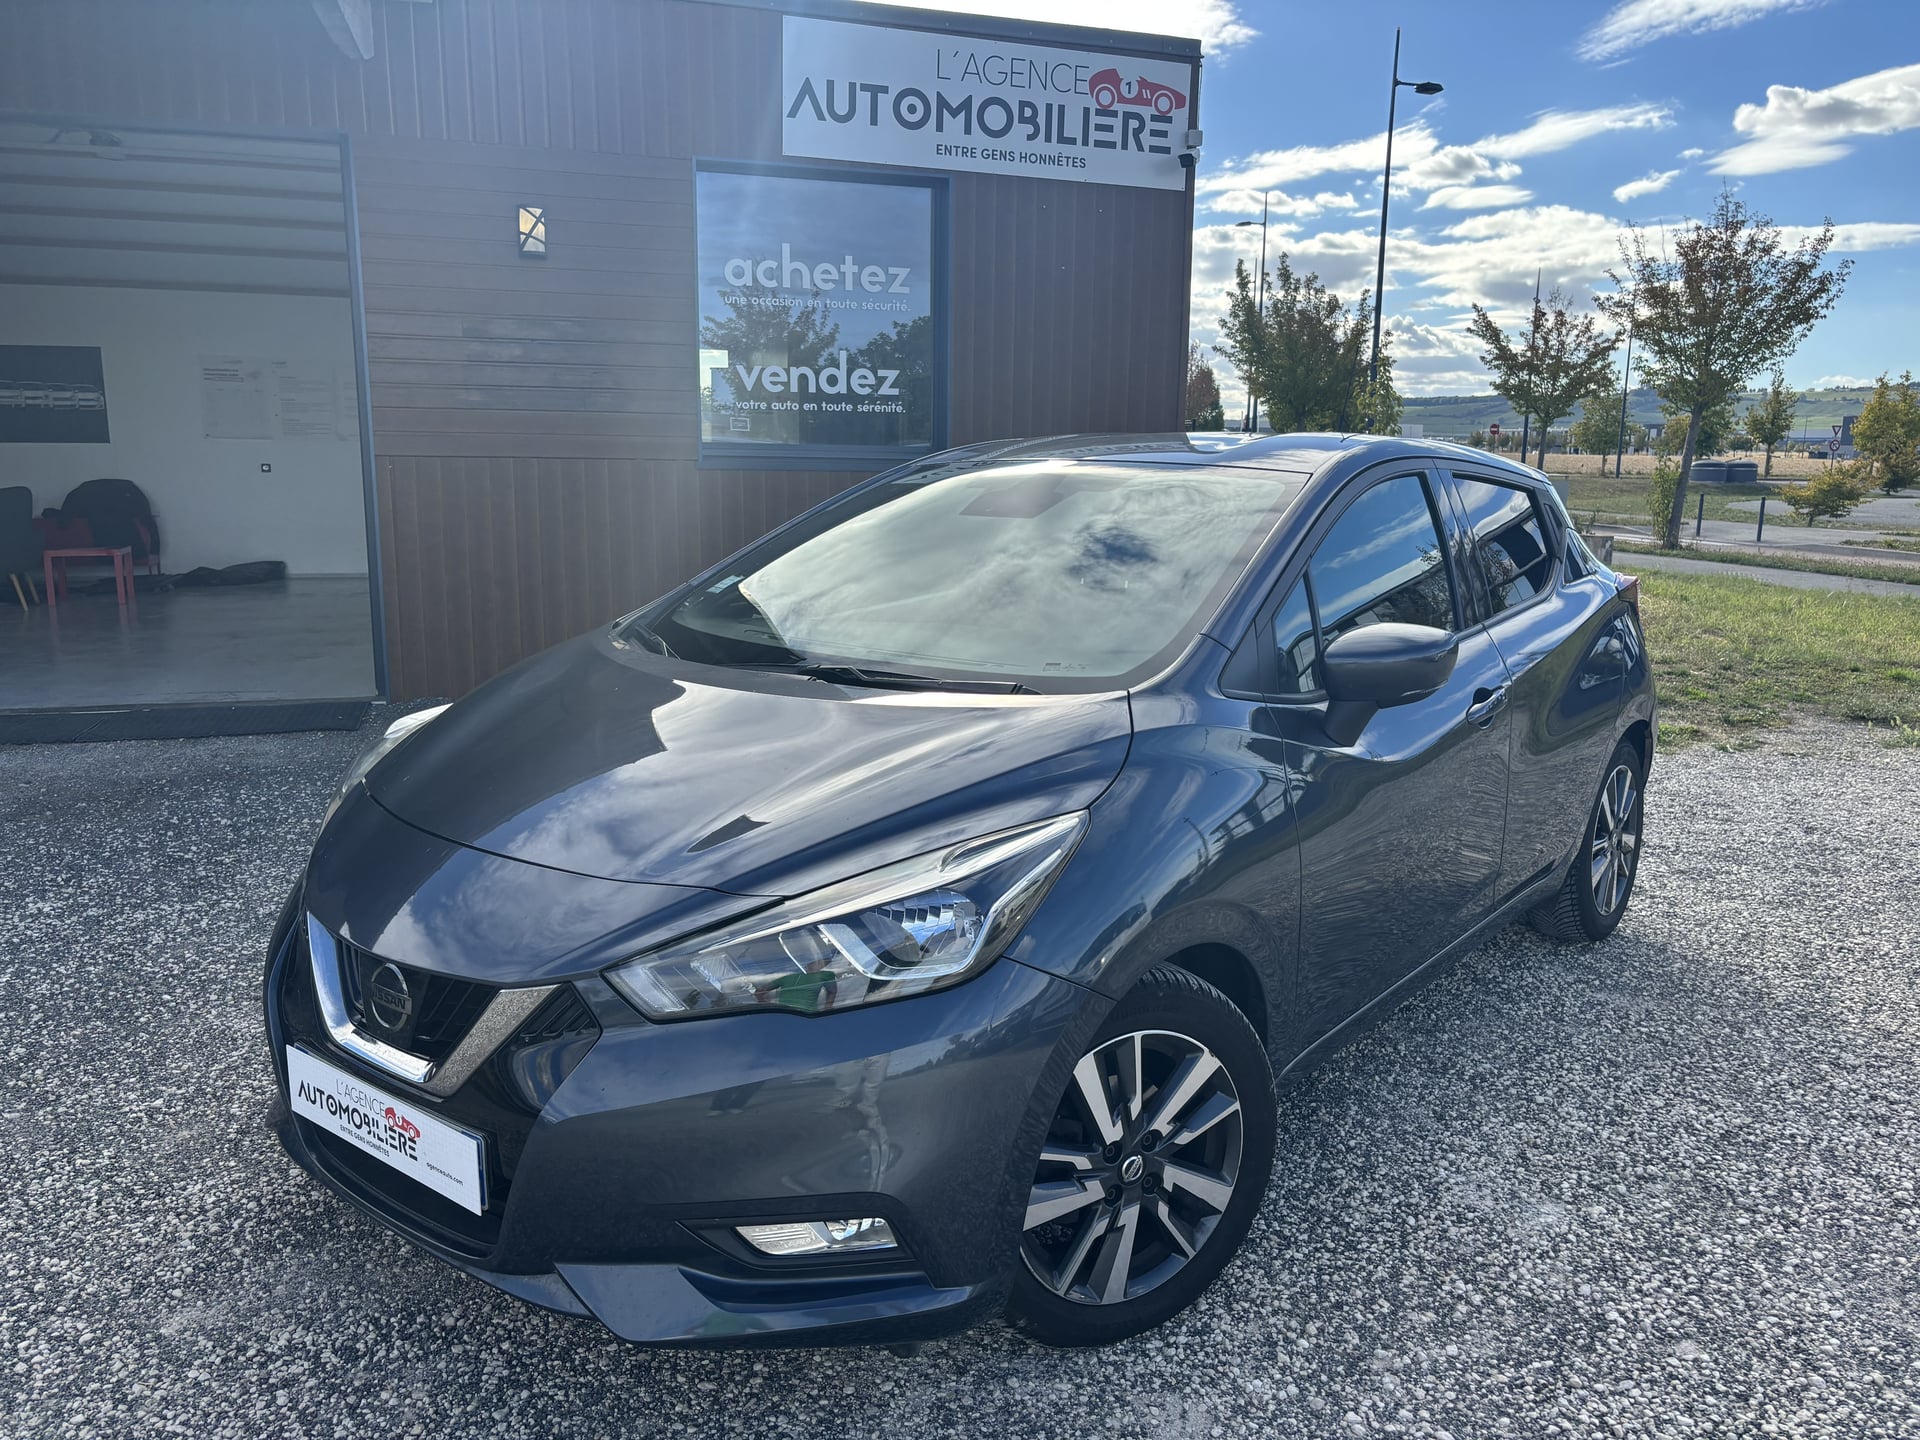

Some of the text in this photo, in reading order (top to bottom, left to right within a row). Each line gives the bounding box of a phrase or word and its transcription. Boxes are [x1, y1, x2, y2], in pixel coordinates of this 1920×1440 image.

[936, 48, 1090, 95] L'AGENCE
[936, 143, 1087, 169] ENTRE GENS HONNÊTES
[723, 243, 911, 294] achetez
[724, 295, 911, 312] une occasion en toute sécurité.
[735, 350, 900, 396] vendez
[736, 400, 906, 414] votre auto en toute sérénité.
[373, 986, 406, 1010] ISSAN
[340, 1124, 354, 1138] ENTRE
